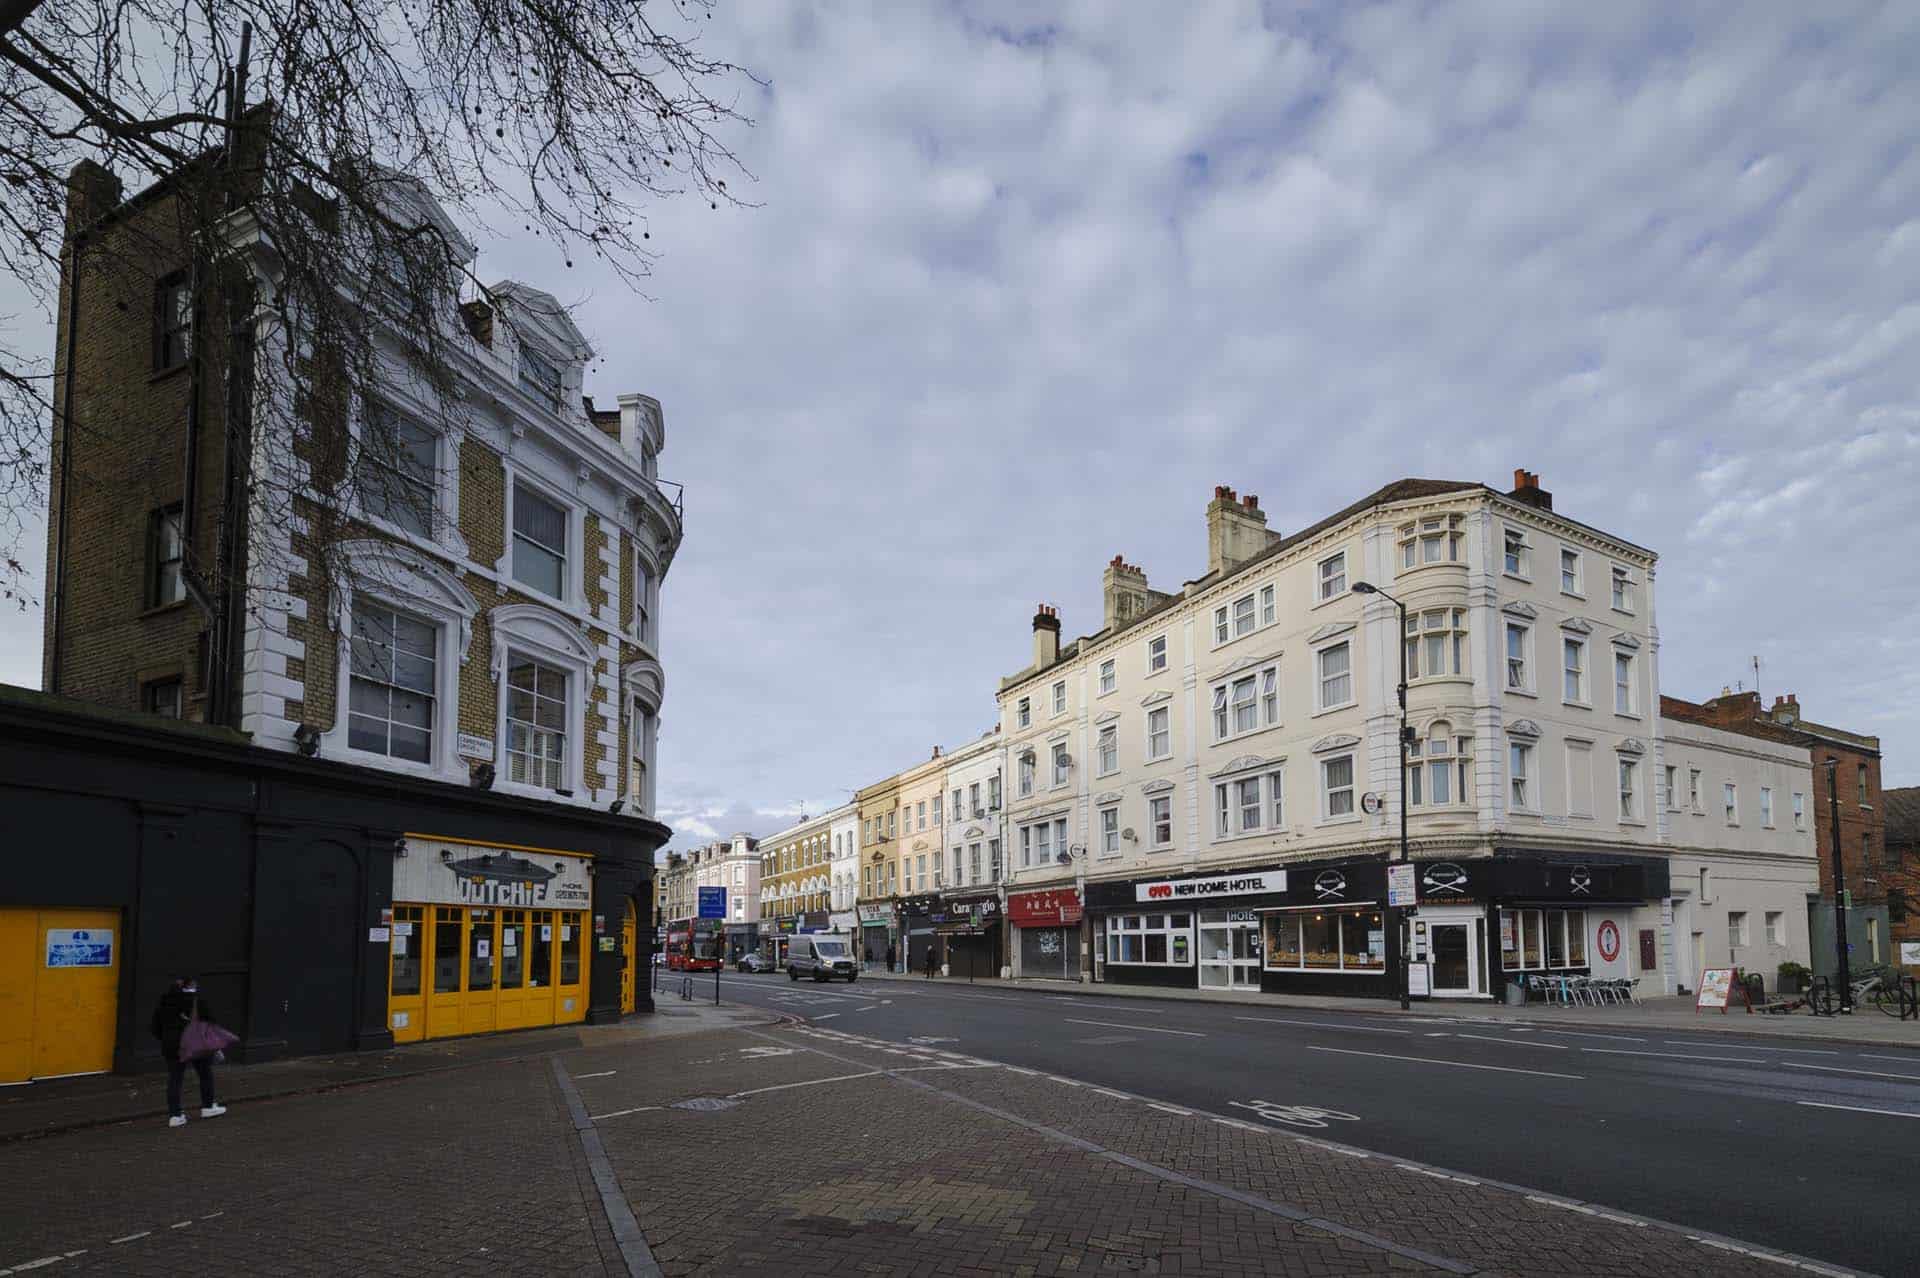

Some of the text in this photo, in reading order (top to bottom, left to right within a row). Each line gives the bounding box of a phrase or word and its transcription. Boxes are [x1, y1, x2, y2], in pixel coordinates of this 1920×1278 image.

[1174, 883, 1196, 896] NEW
[1198, 880, 1228, 894] DOME
[1230, 877, 1266, 891] HOTEL
[952, 898, 996, 914] Caragio
